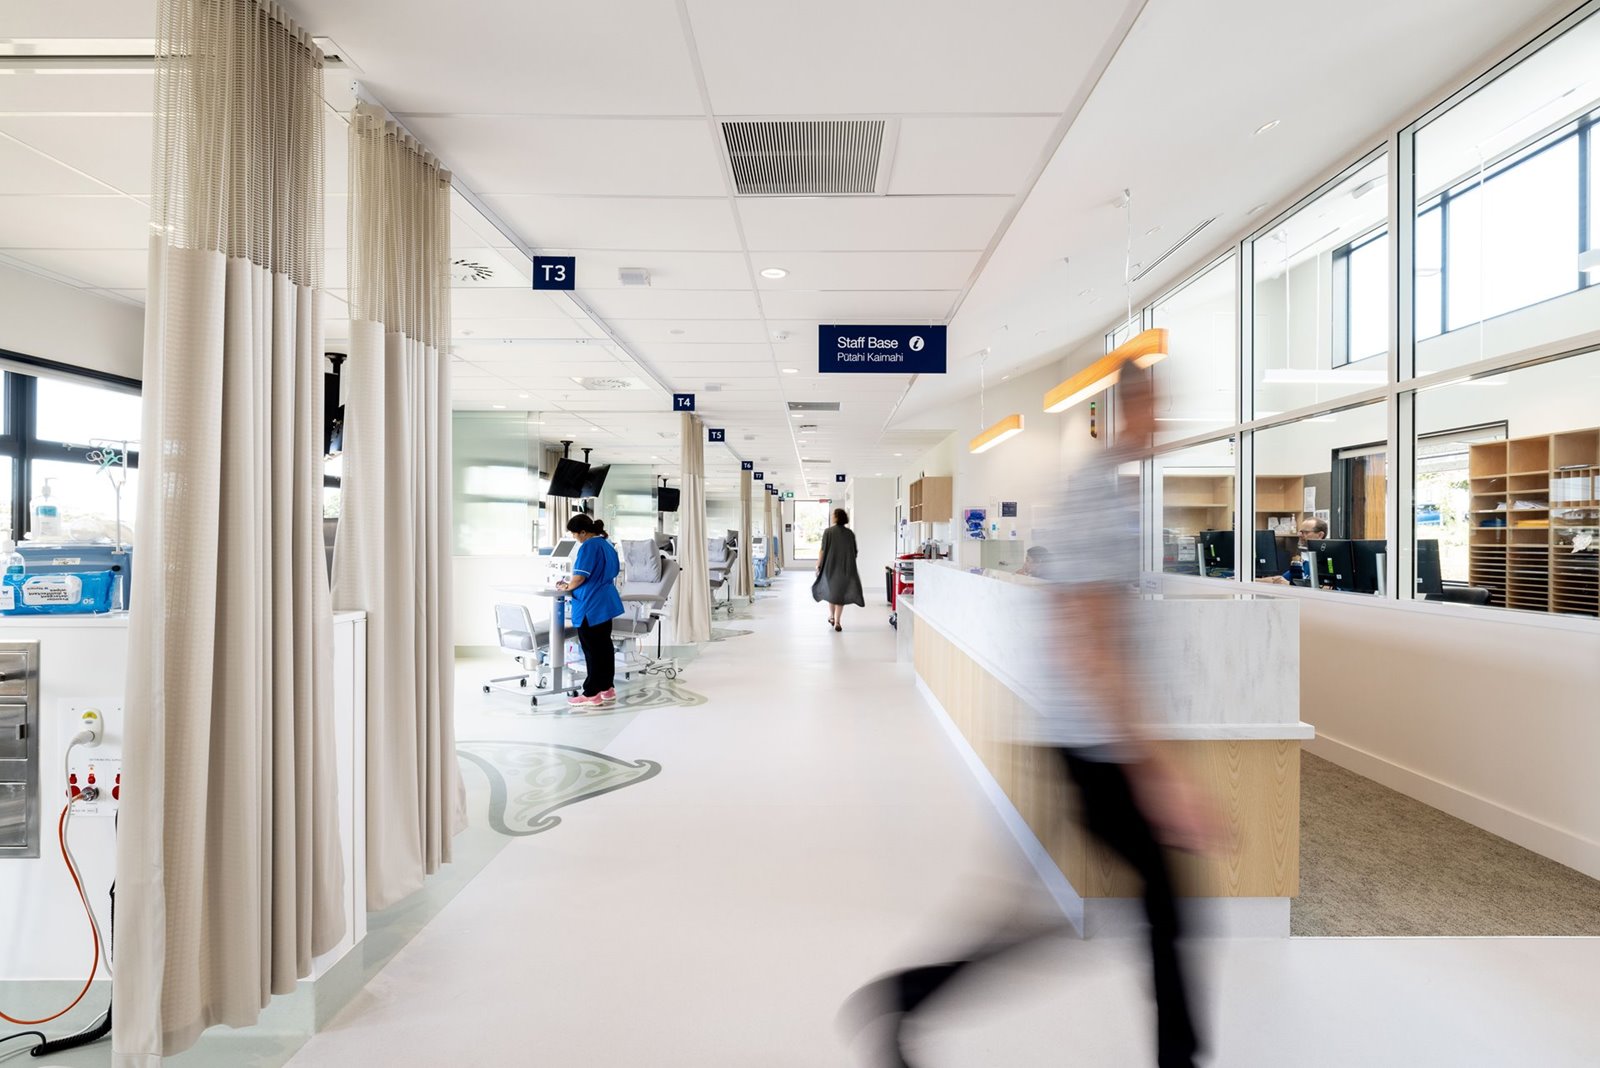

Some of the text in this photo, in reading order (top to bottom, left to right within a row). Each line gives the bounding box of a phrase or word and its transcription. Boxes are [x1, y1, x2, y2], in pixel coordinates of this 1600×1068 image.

[541, 264, 566, 281] T3
[837, 336, 899, 348] Staff Base
[867, 352, 904, 361] Kaimahi
[677, 397, 691, 407] T4
[711, 431, 722, 439] T5
